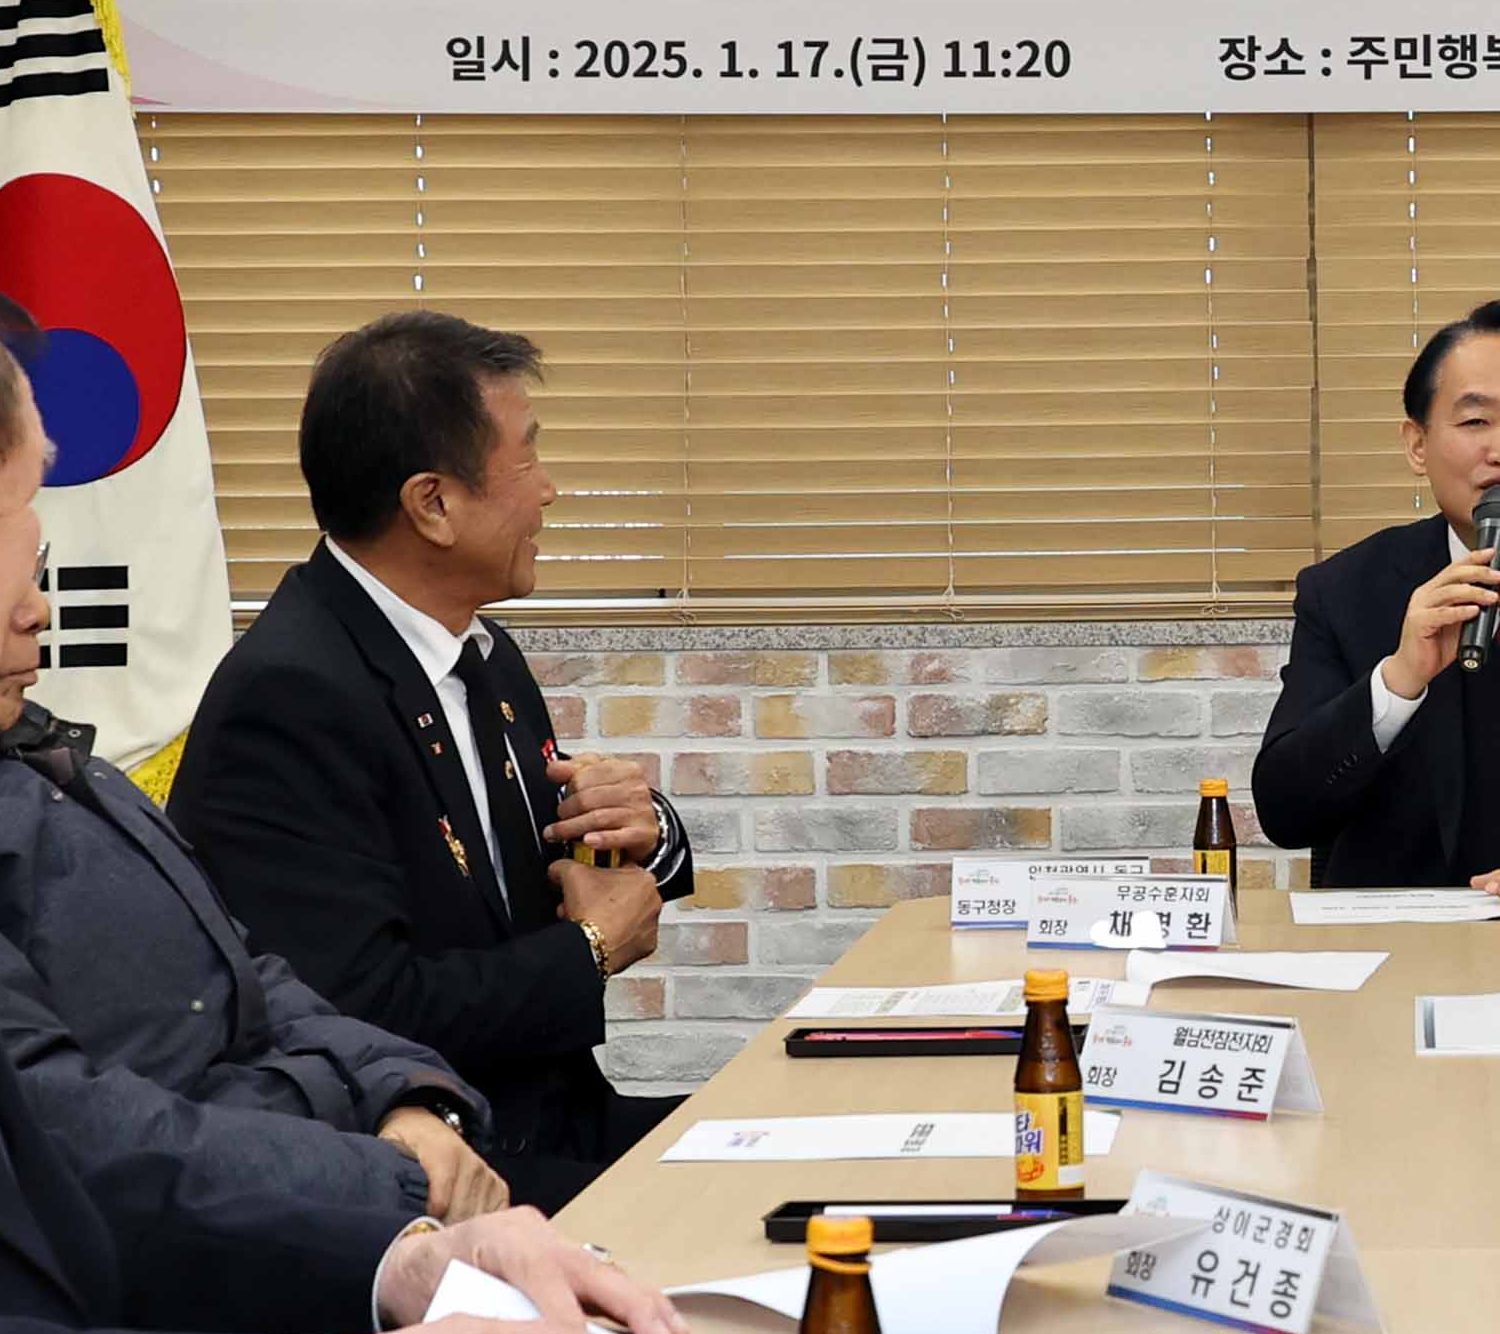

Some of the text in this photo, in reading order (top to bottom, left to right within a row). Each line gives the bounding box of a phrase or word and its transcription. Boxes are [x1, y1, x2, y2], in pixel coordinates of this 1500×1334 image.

[446, 35, 530, 82] 일시
[574, 39, 703, 79] 2025.
[719, 40, 759, 79] 1.
[776, 36, 926, 88] 17.(금)
[943, 40, 1071, 79] 11:20
[1218, 34, 1306, 81] 장소
[958, 899, 1016, 915] 동구청장
[1039, 919, 1068, 936] 회장
[1086, 1065, 1117, 1088] 회장
[1211, 1205, 1316, 1253] 상이군경회
[1124, 1250, 1157, 1281] 회장
